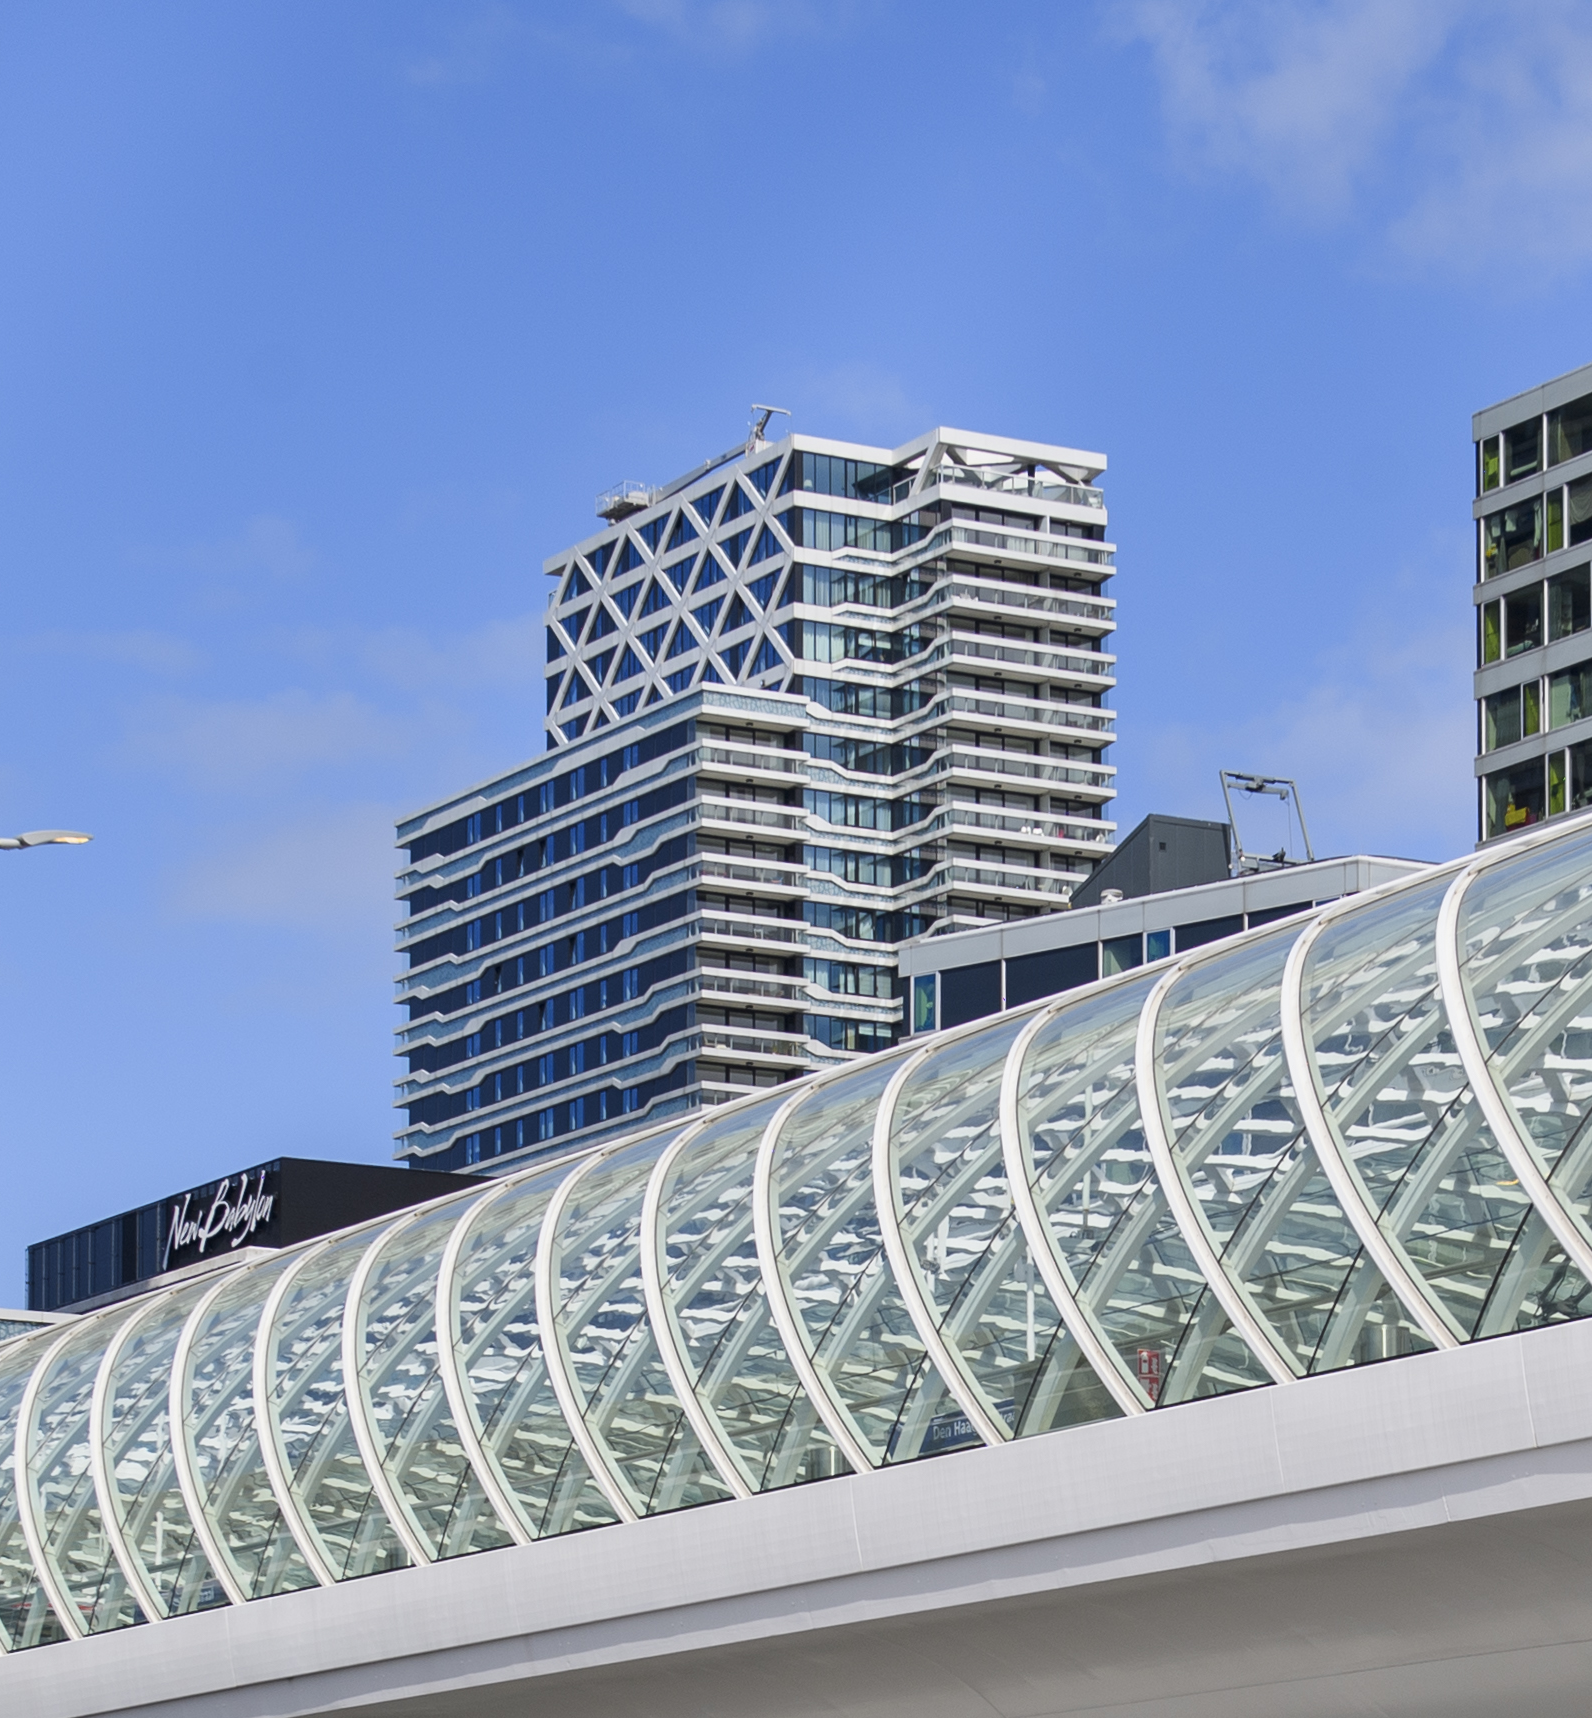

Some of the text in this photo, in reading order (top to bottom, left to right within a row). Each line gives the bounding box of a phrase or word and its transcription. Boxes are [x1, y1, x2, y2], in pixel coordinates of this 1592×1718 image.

[162, 1169, 274, 1271] New Babylon
[933, 1425, 951, 1439] Den
